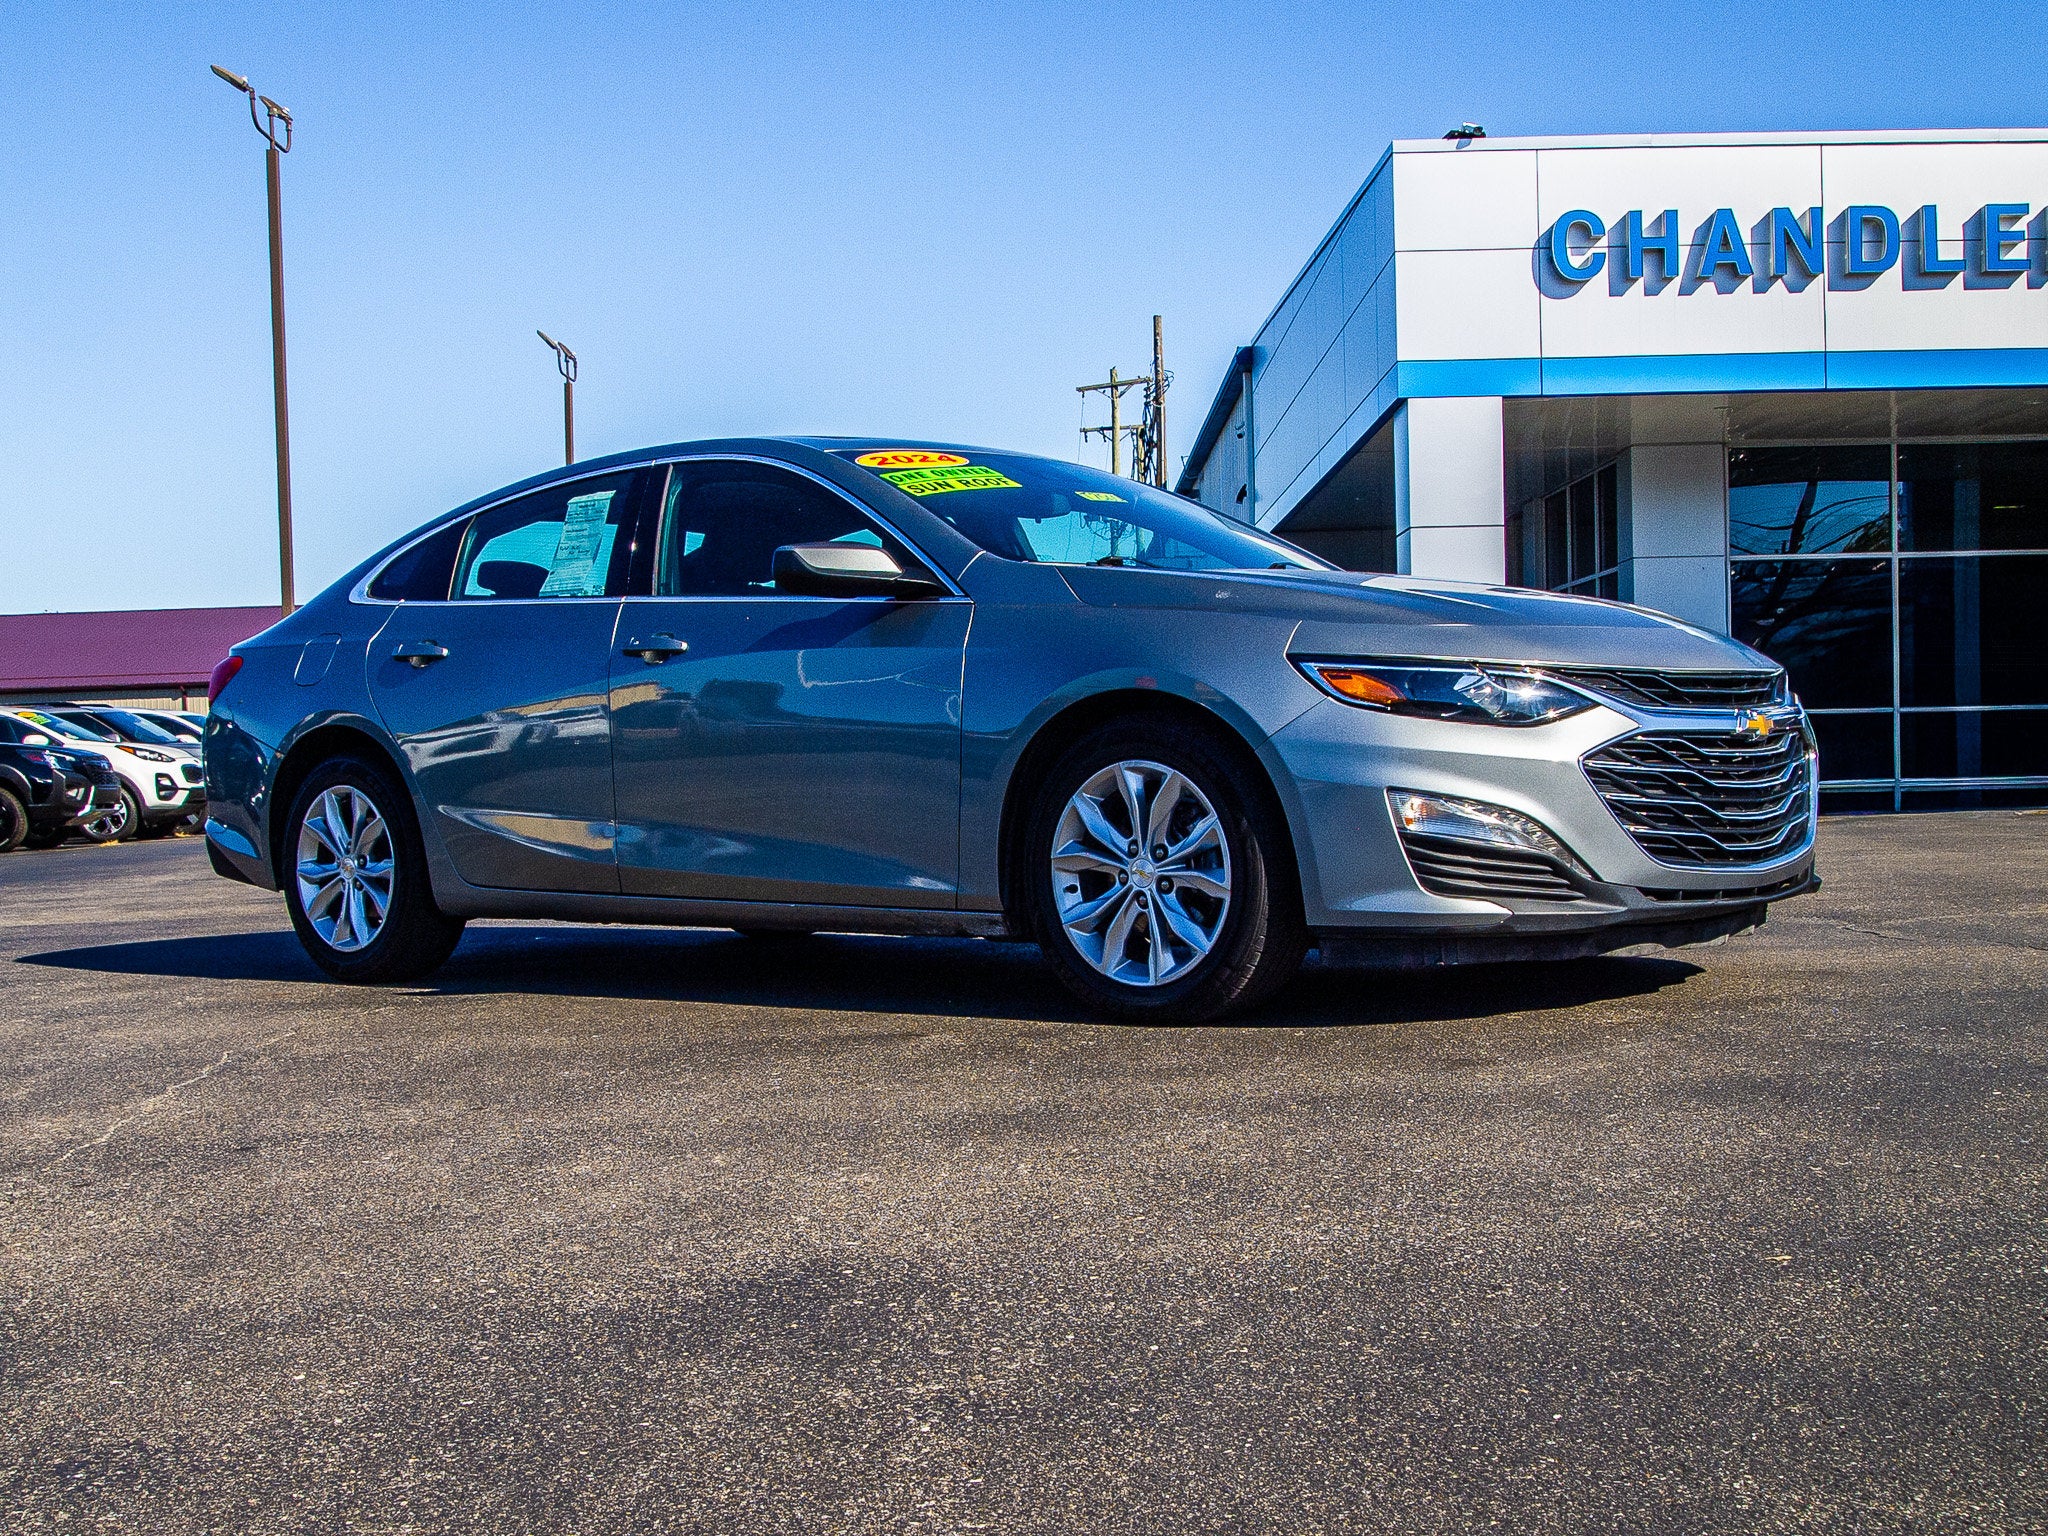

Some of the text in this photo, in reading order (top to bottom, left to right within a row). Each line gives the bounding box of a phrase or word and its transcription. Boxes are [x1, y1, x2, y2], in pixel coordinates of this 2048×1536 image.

[1551, 203, 2047, 281] CHANDLE
[870, 454, 957, 466] 2024
[889, 466, 995, 483] ONE OWNER
[906, 476, 1011, 494] SUN ROOF
